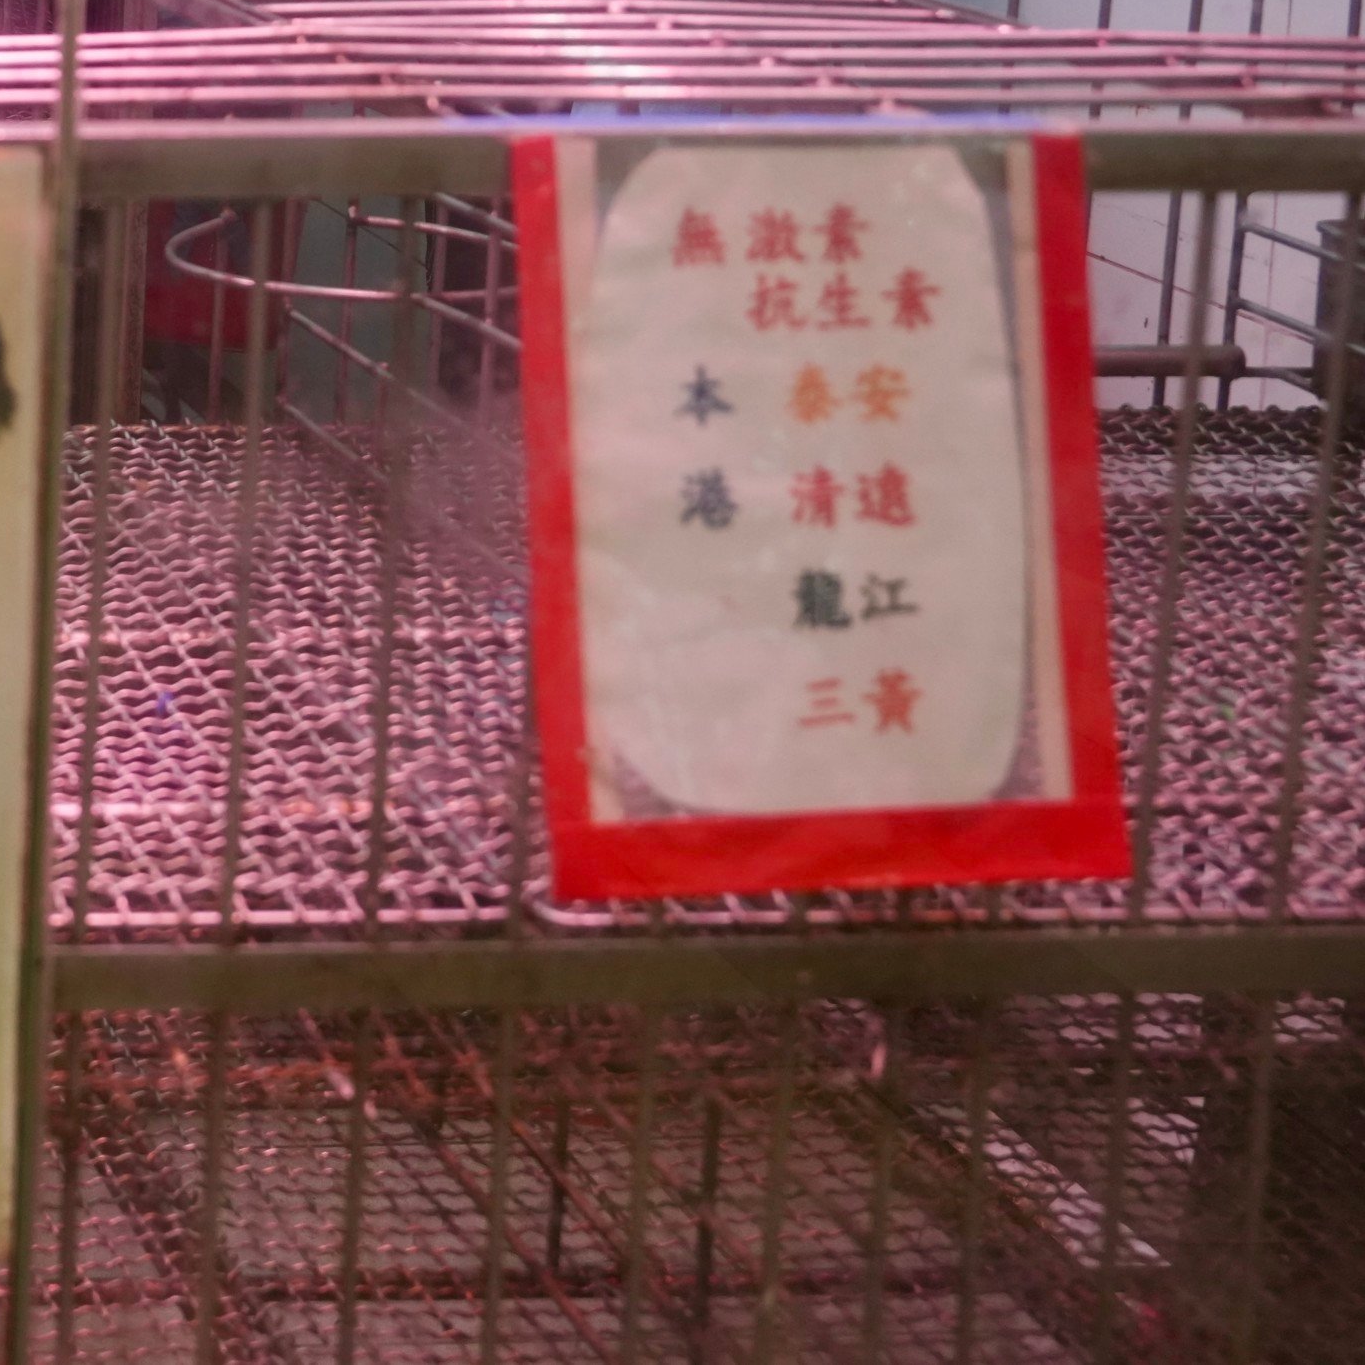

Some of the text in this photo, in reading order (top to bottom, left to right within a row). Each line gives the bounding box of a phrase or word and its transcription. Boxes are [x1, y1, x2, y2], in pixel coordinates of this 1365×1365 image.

[671, 204, 870, 267] 無激素
[745, 273, 942, 333] 抗生素
[785, 363, 911, 425] 泰安
[789, 465, 918, 531] 清遠
[794, 569, 921, 629] 龍江
[798, 668, 924, 734] 三黃
